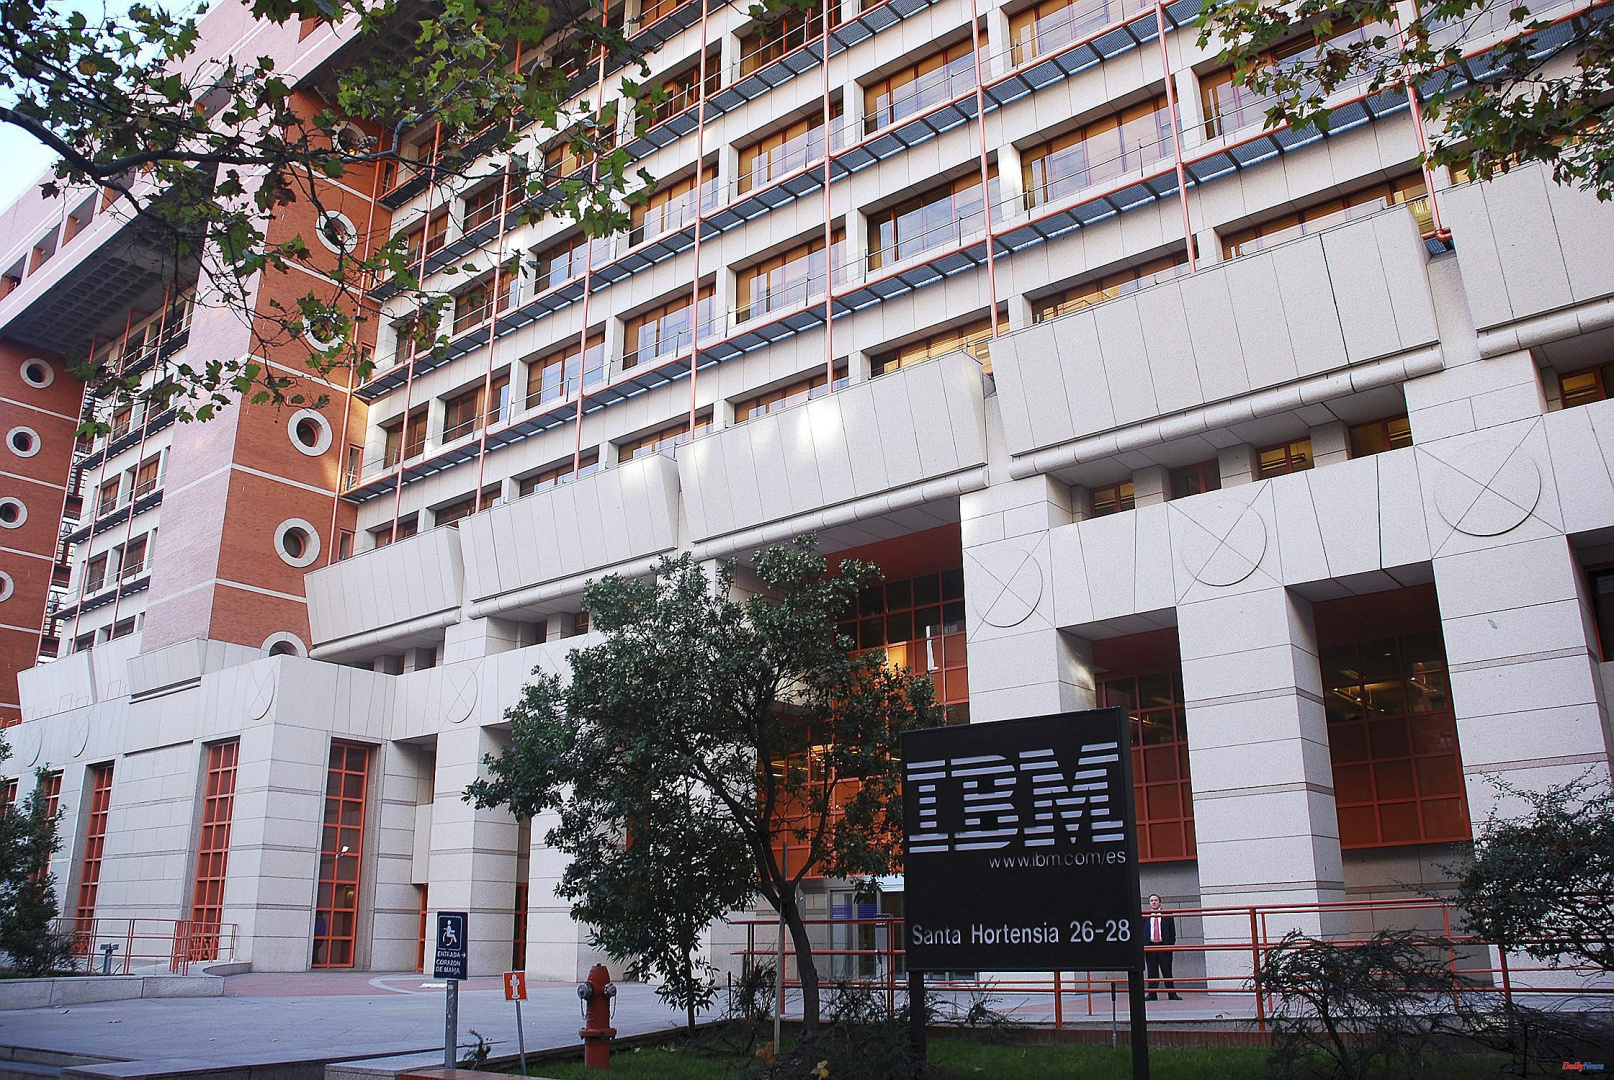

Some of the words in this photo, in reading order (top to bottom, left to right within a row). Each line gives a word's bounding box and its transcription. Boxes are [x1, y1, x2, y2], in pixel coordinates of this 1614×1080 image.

[907, 741, 1124, 853] IBM
[988, 849, 1126, 869] www.ibm.com/es
[912, 924, 961, 945] Santa
[971, 922, 1059, 944] Hortensia
[1069, 919, 1131, 943] 26-28
